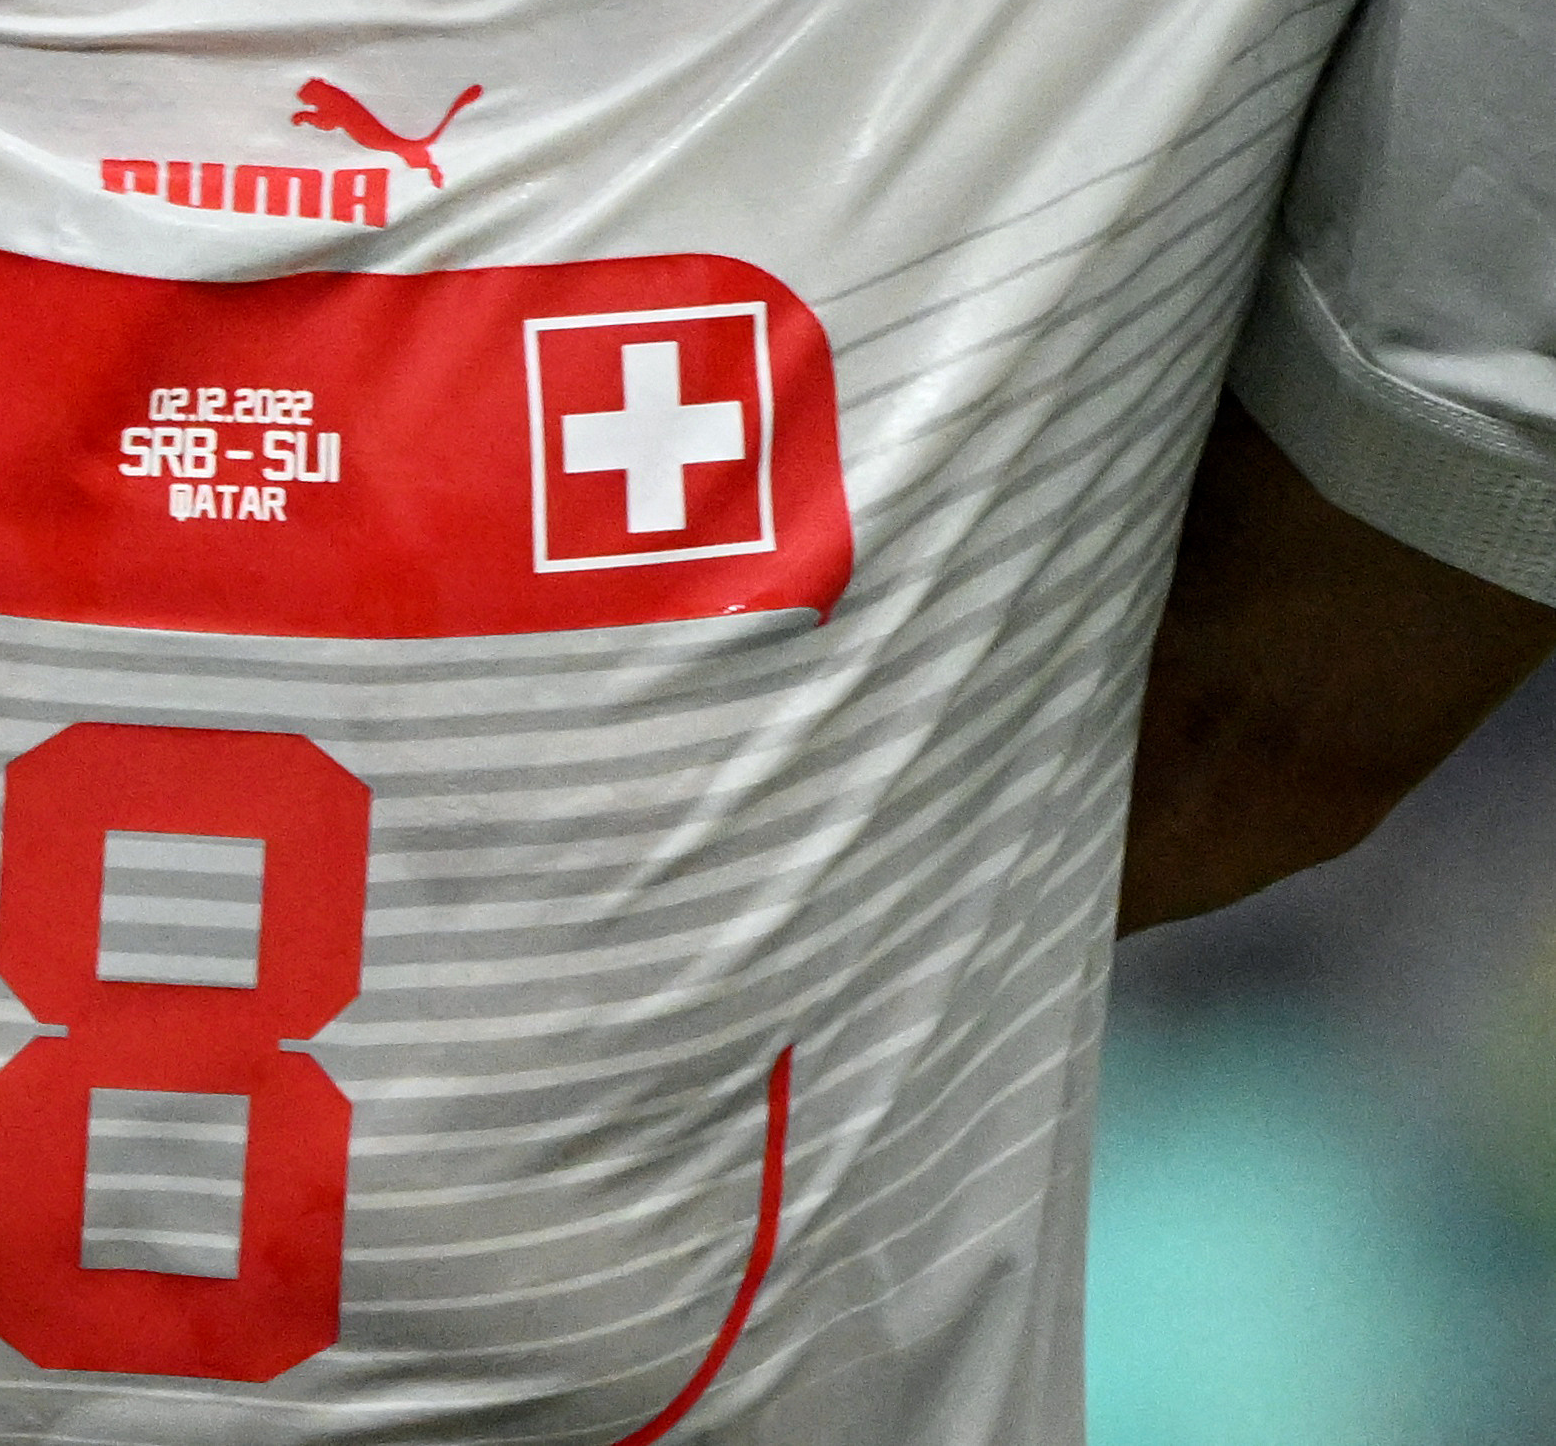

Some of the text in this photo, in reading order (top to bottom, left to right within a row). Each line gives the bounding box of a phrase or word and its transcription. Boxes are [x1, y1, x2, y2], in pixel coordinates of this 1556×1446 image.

[148, 387, 315, 425] 02.12.2022
[118, 426, 219, 479] SRB
[261, 429, 341, 483] SUI
[168, 482, 288, 522] QATAR
